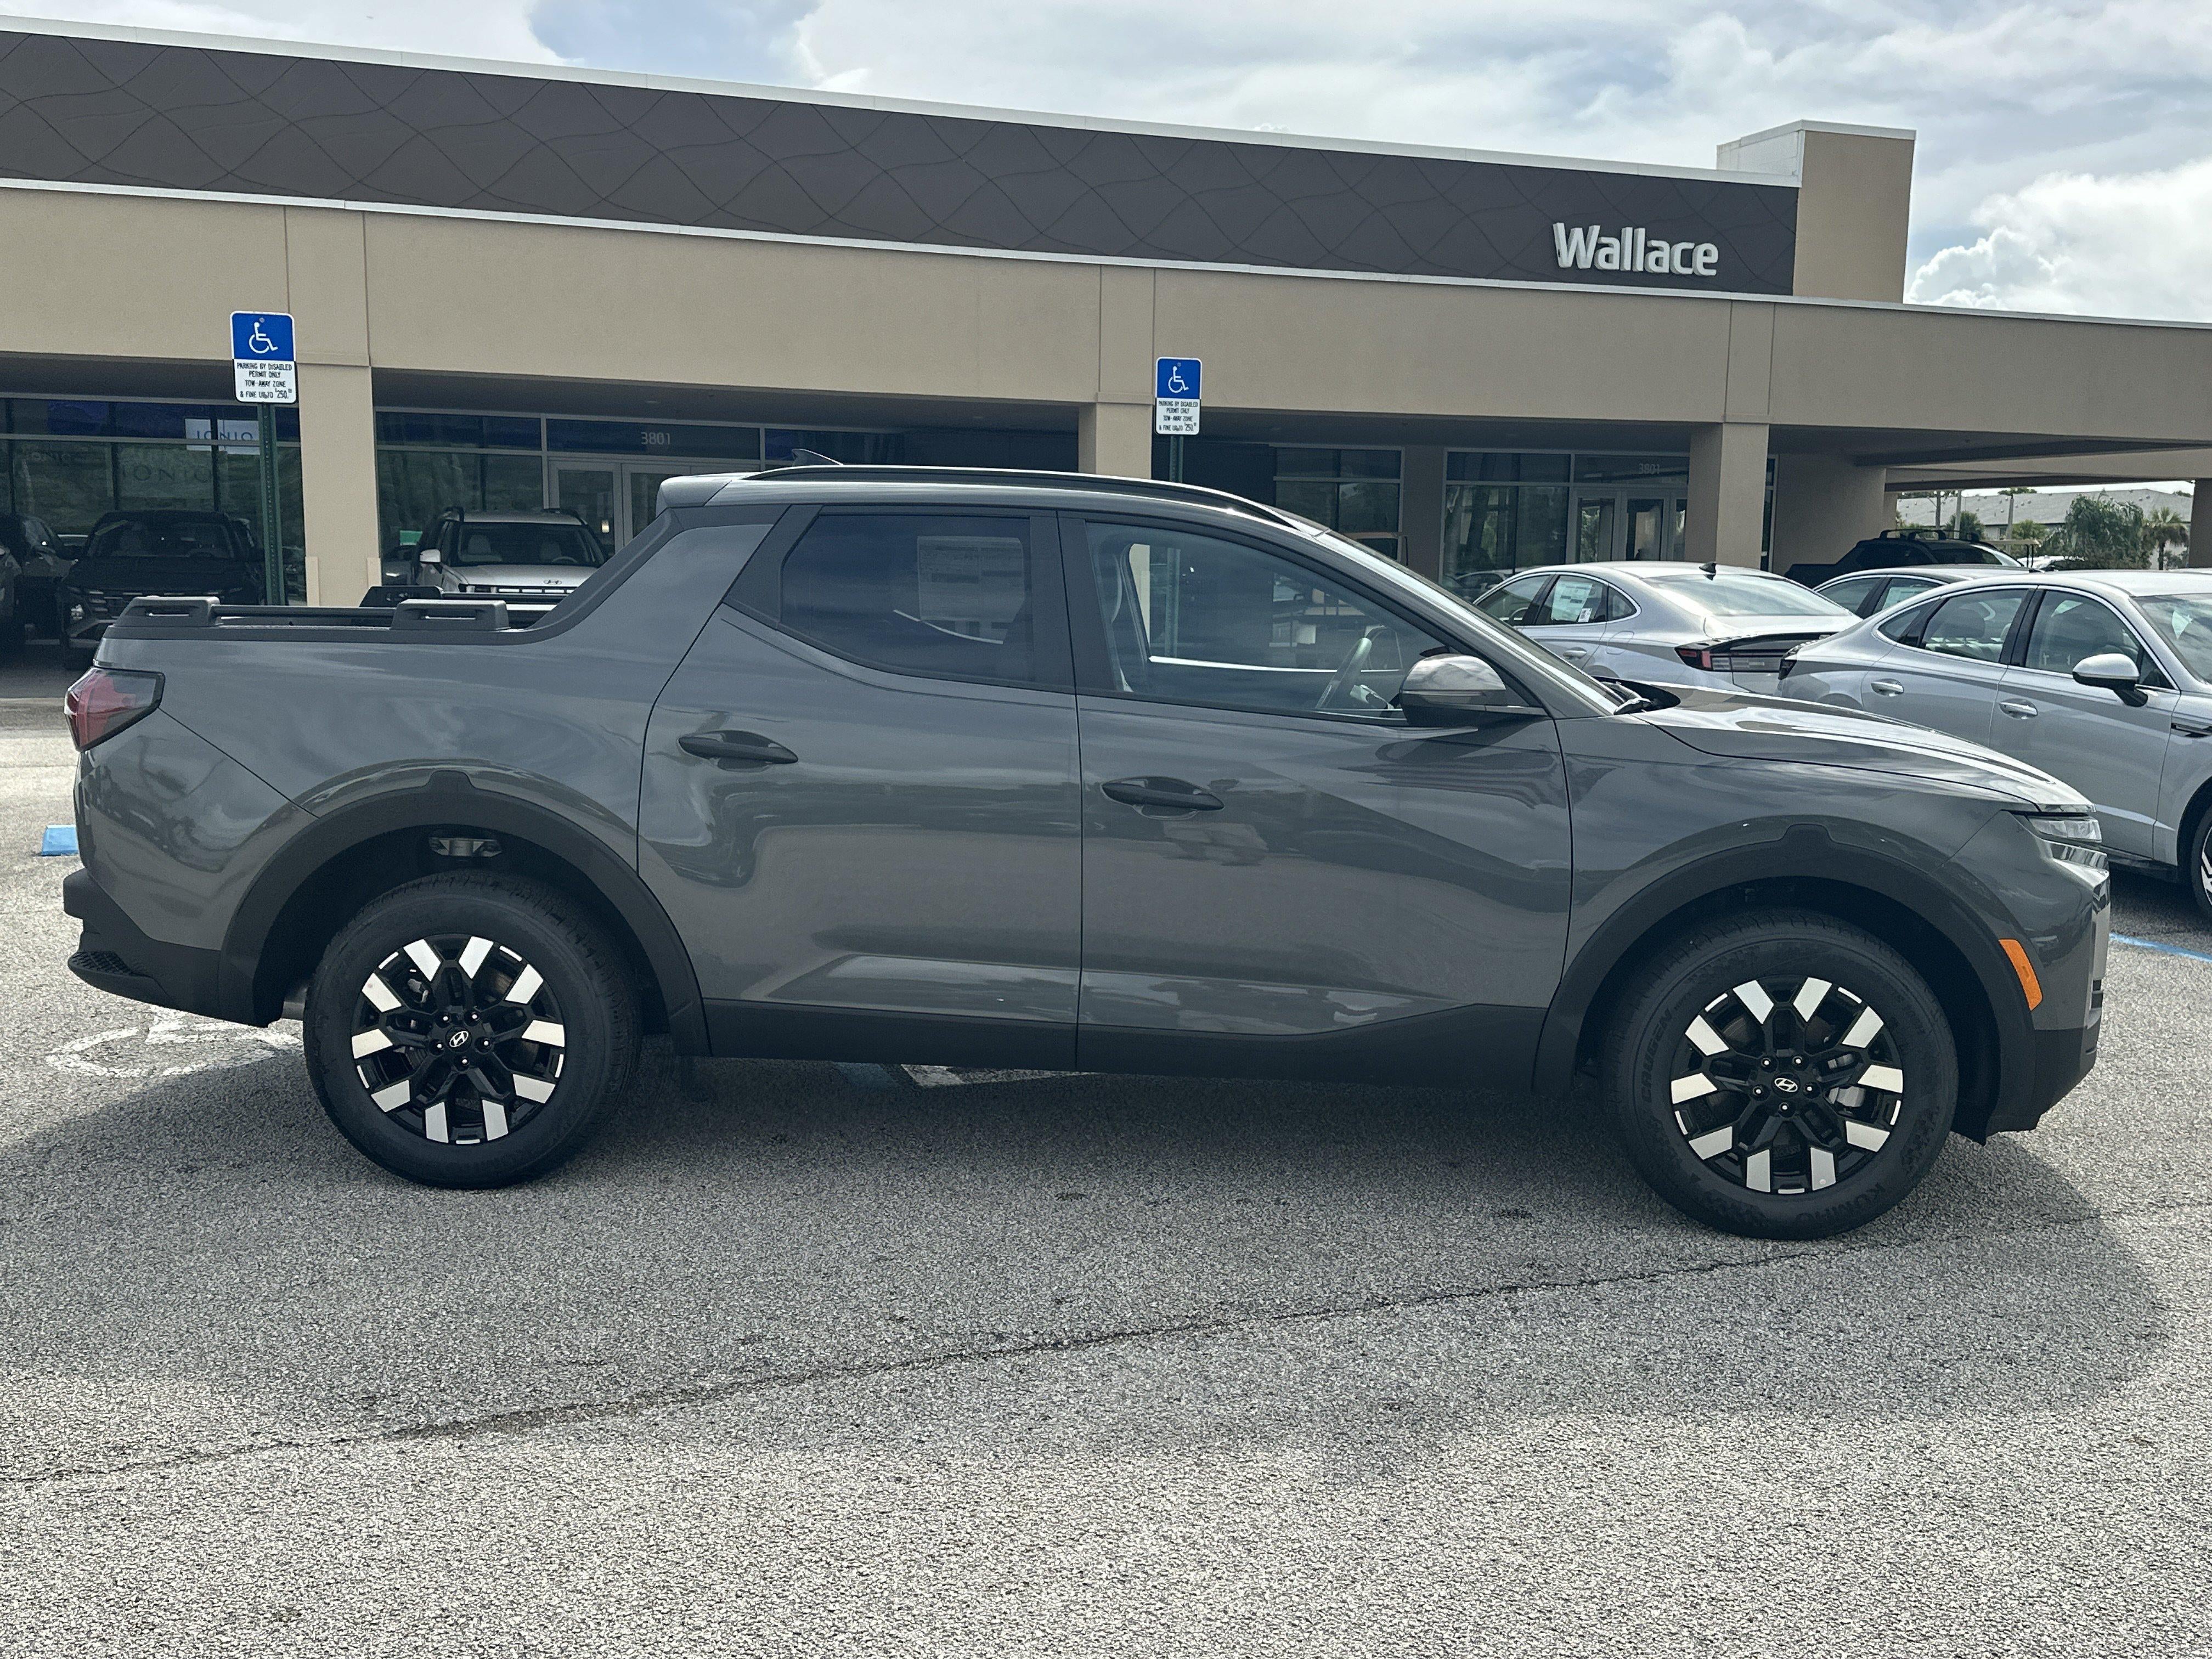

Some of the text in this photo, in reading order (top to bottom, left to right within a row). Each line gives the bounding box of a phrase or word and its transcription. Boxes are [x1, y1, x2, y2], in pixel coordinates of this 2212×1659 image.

[1553, 222, 1718, 276] Wallace
[641, 432, 670, 445] 3801
[1638, 463, 1660, 475] 3801
